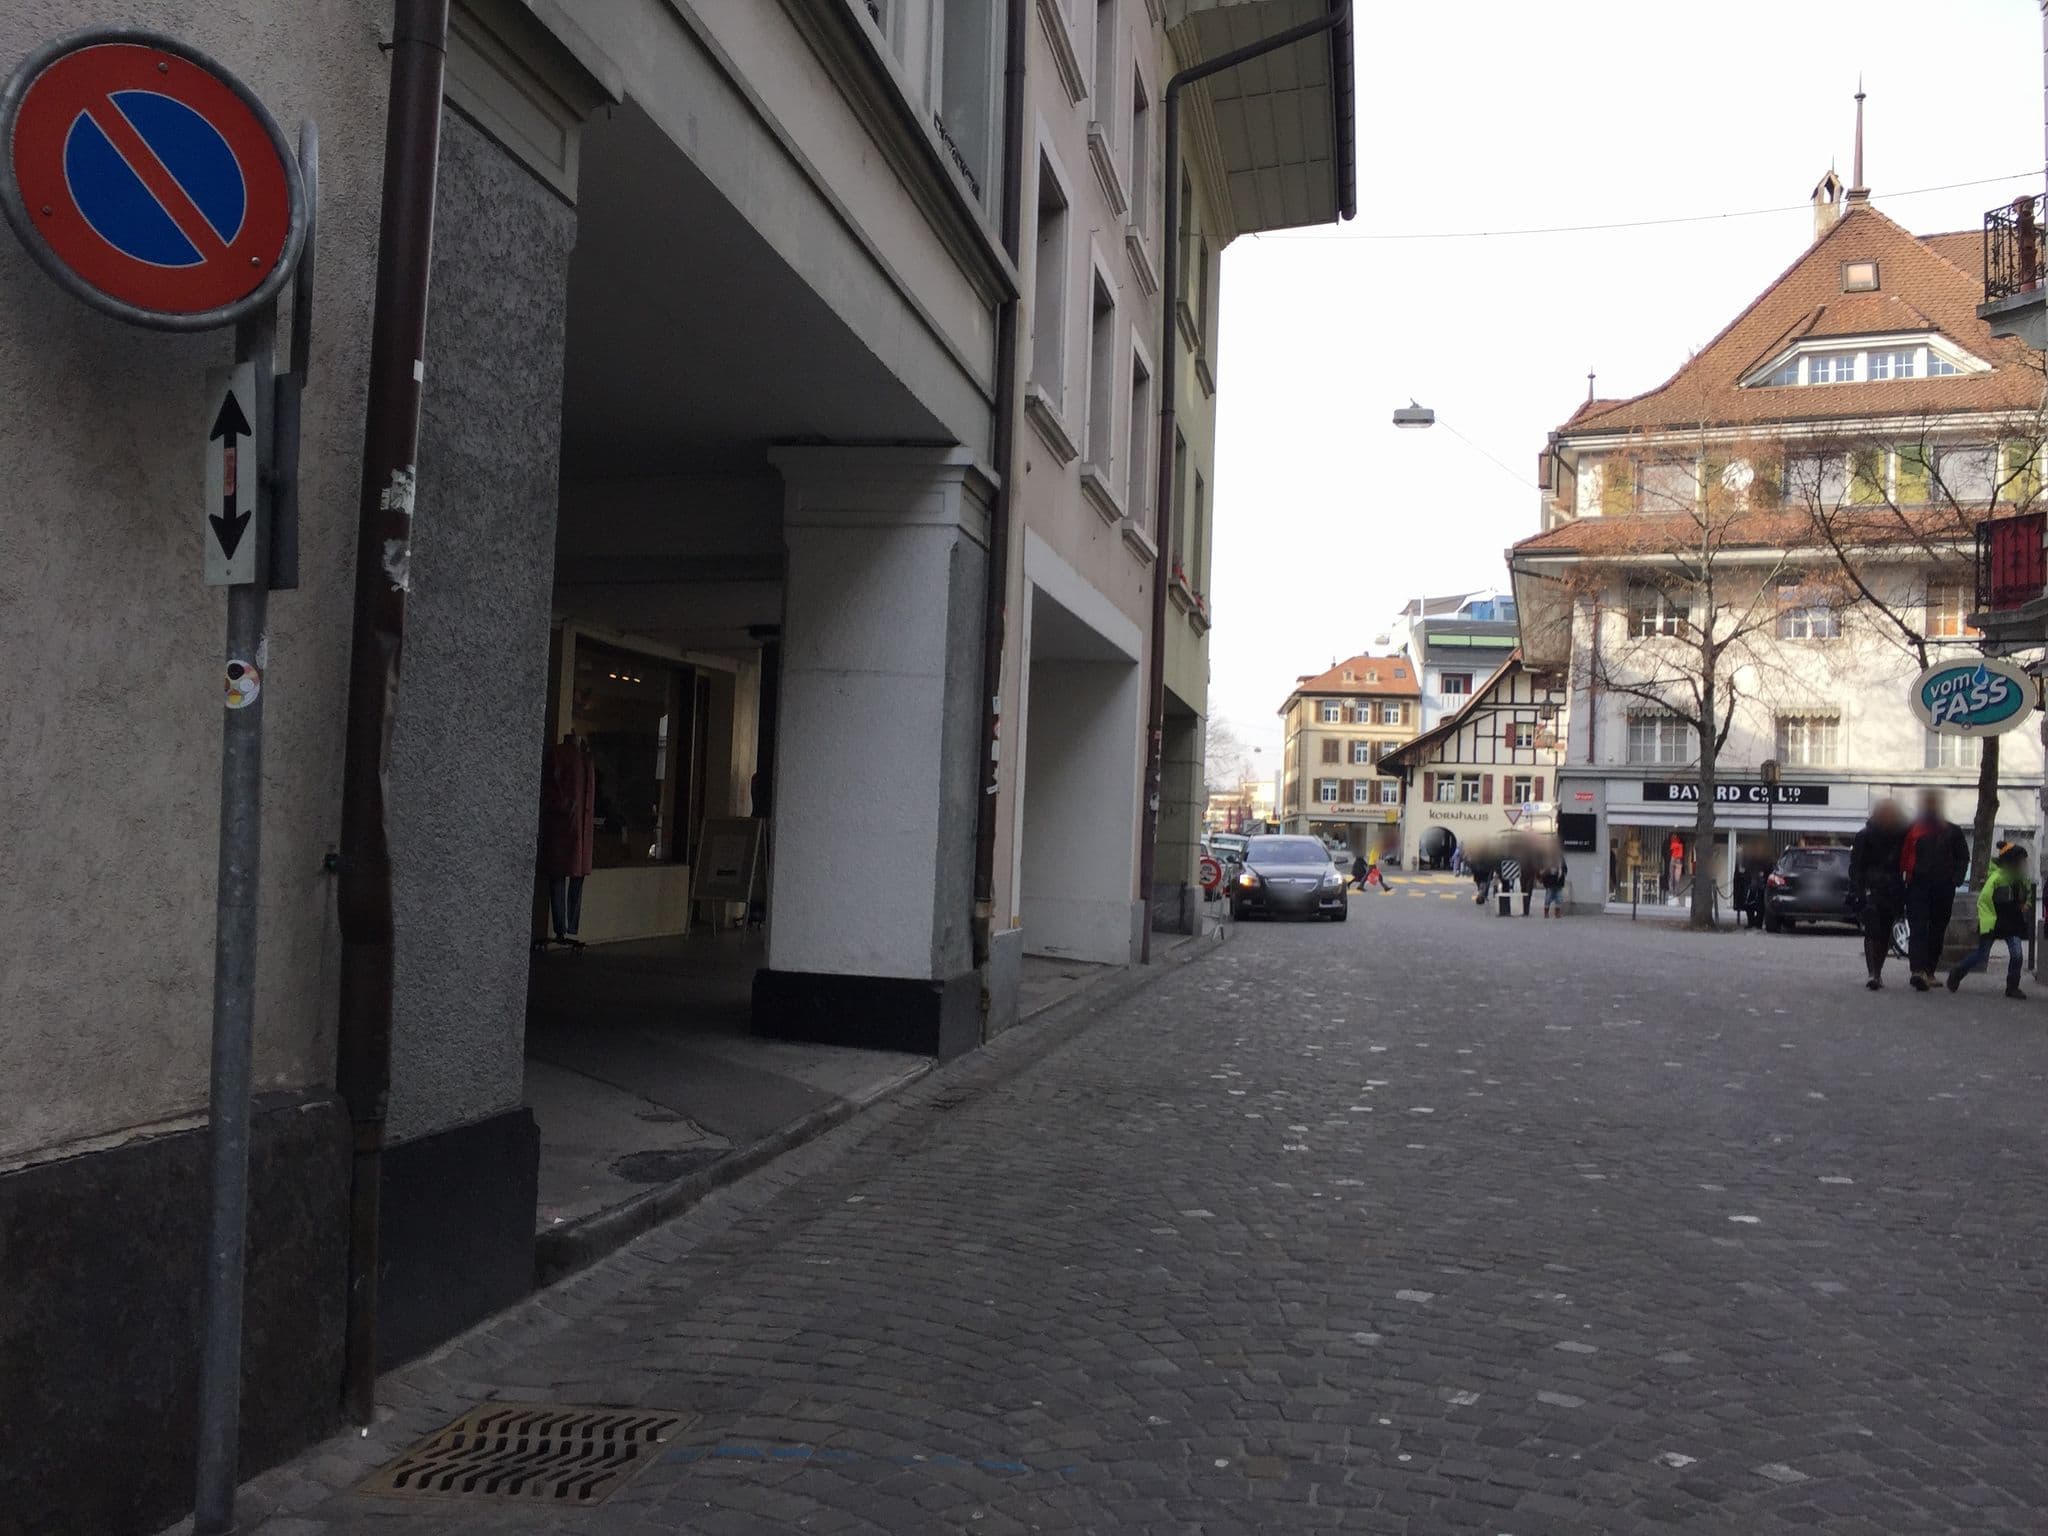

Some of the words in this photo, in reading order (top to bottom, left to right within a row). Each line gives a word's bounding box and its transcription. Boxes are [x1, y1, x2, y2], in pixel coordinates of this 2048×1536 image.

[1930, 673, 1970, 698] vom
[1931, 677, 2008, 725] FASS
[1669, 784, 1741, 801] BAYRD
